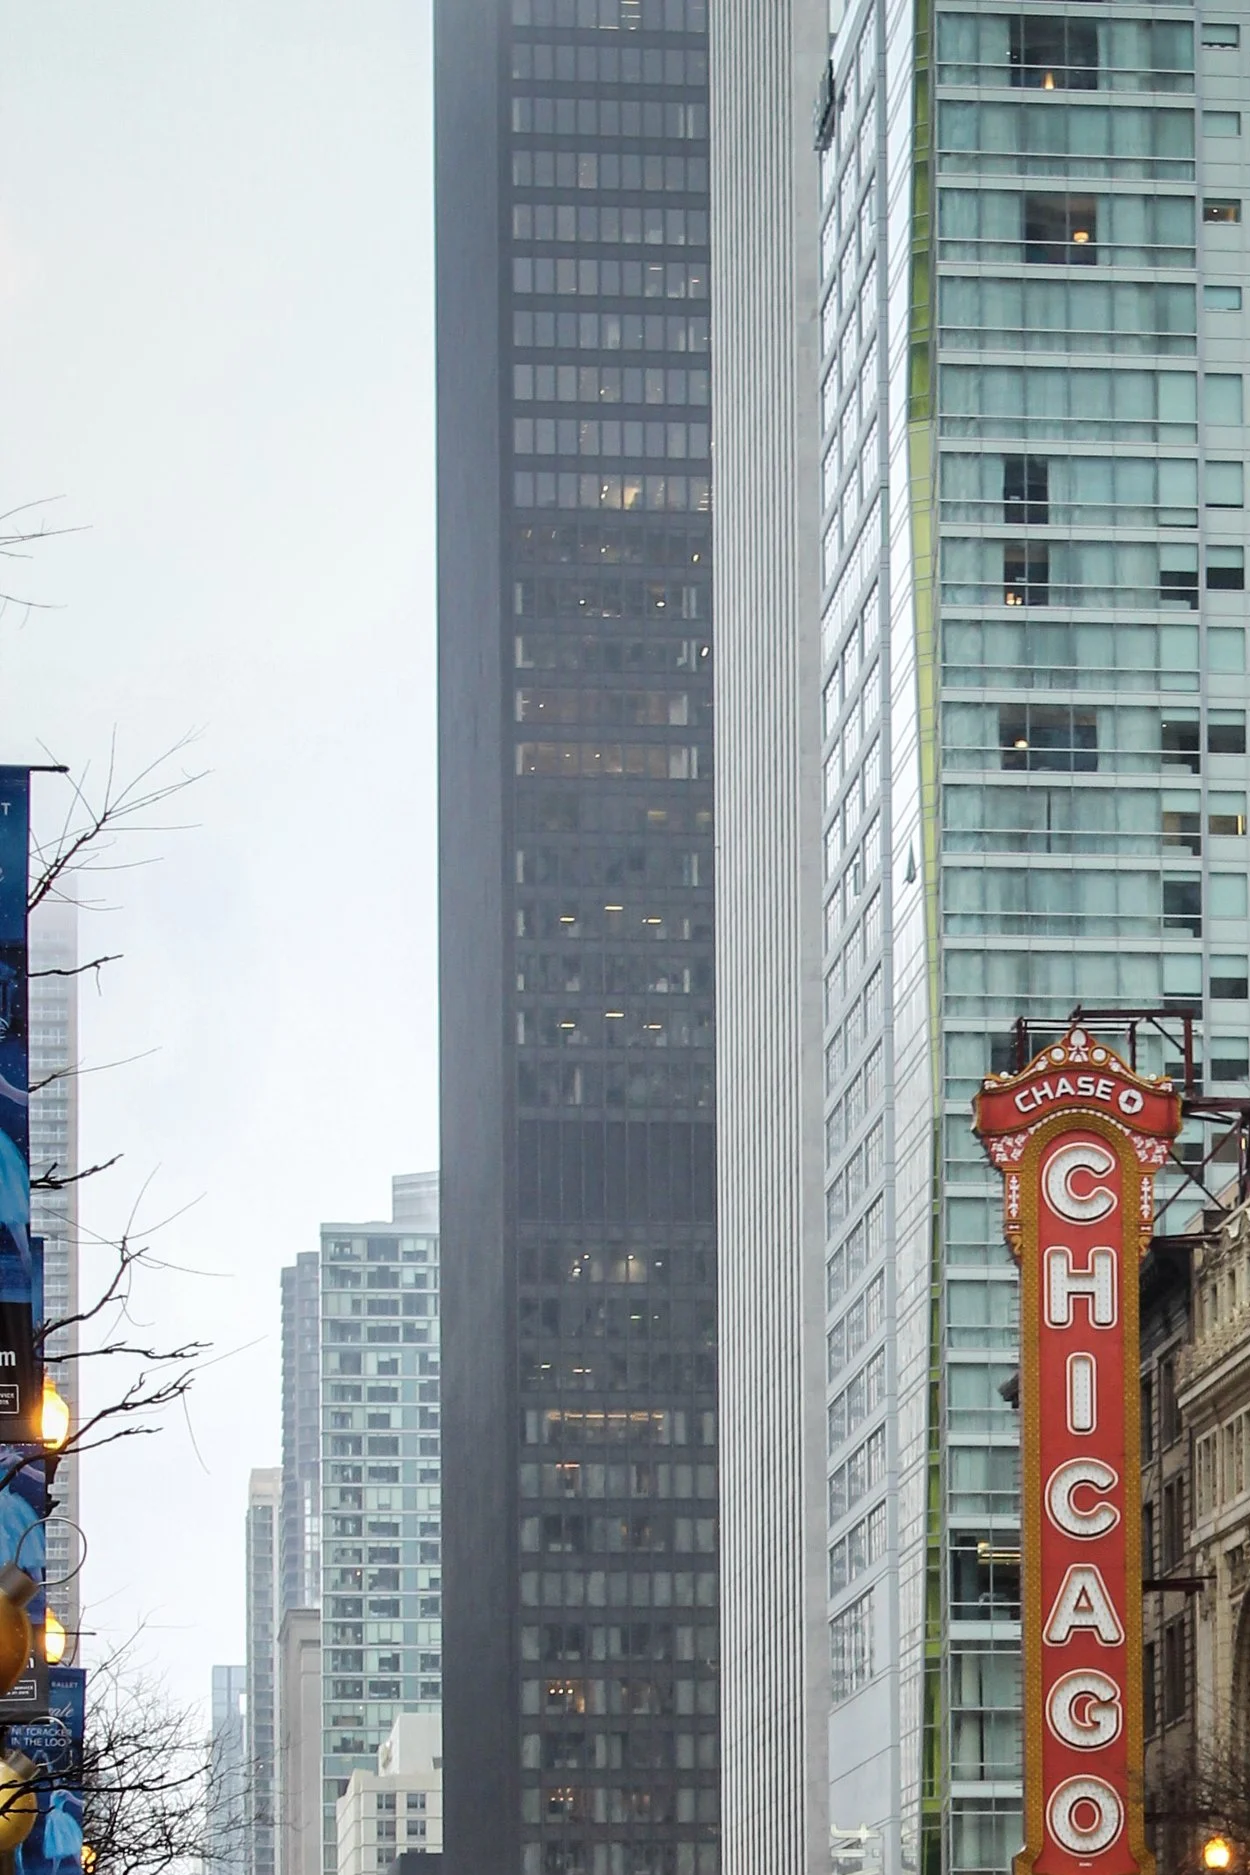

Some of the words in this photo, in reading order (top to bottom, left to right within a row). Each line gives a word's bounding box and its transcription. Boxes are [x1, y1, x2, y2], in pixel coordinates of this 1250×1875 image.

[1014, 1076, 1116, 1113] CHASE
[1041, 1141, 1126, 1857] CHICAGO
[24, 1737, 42, 1747] THE
